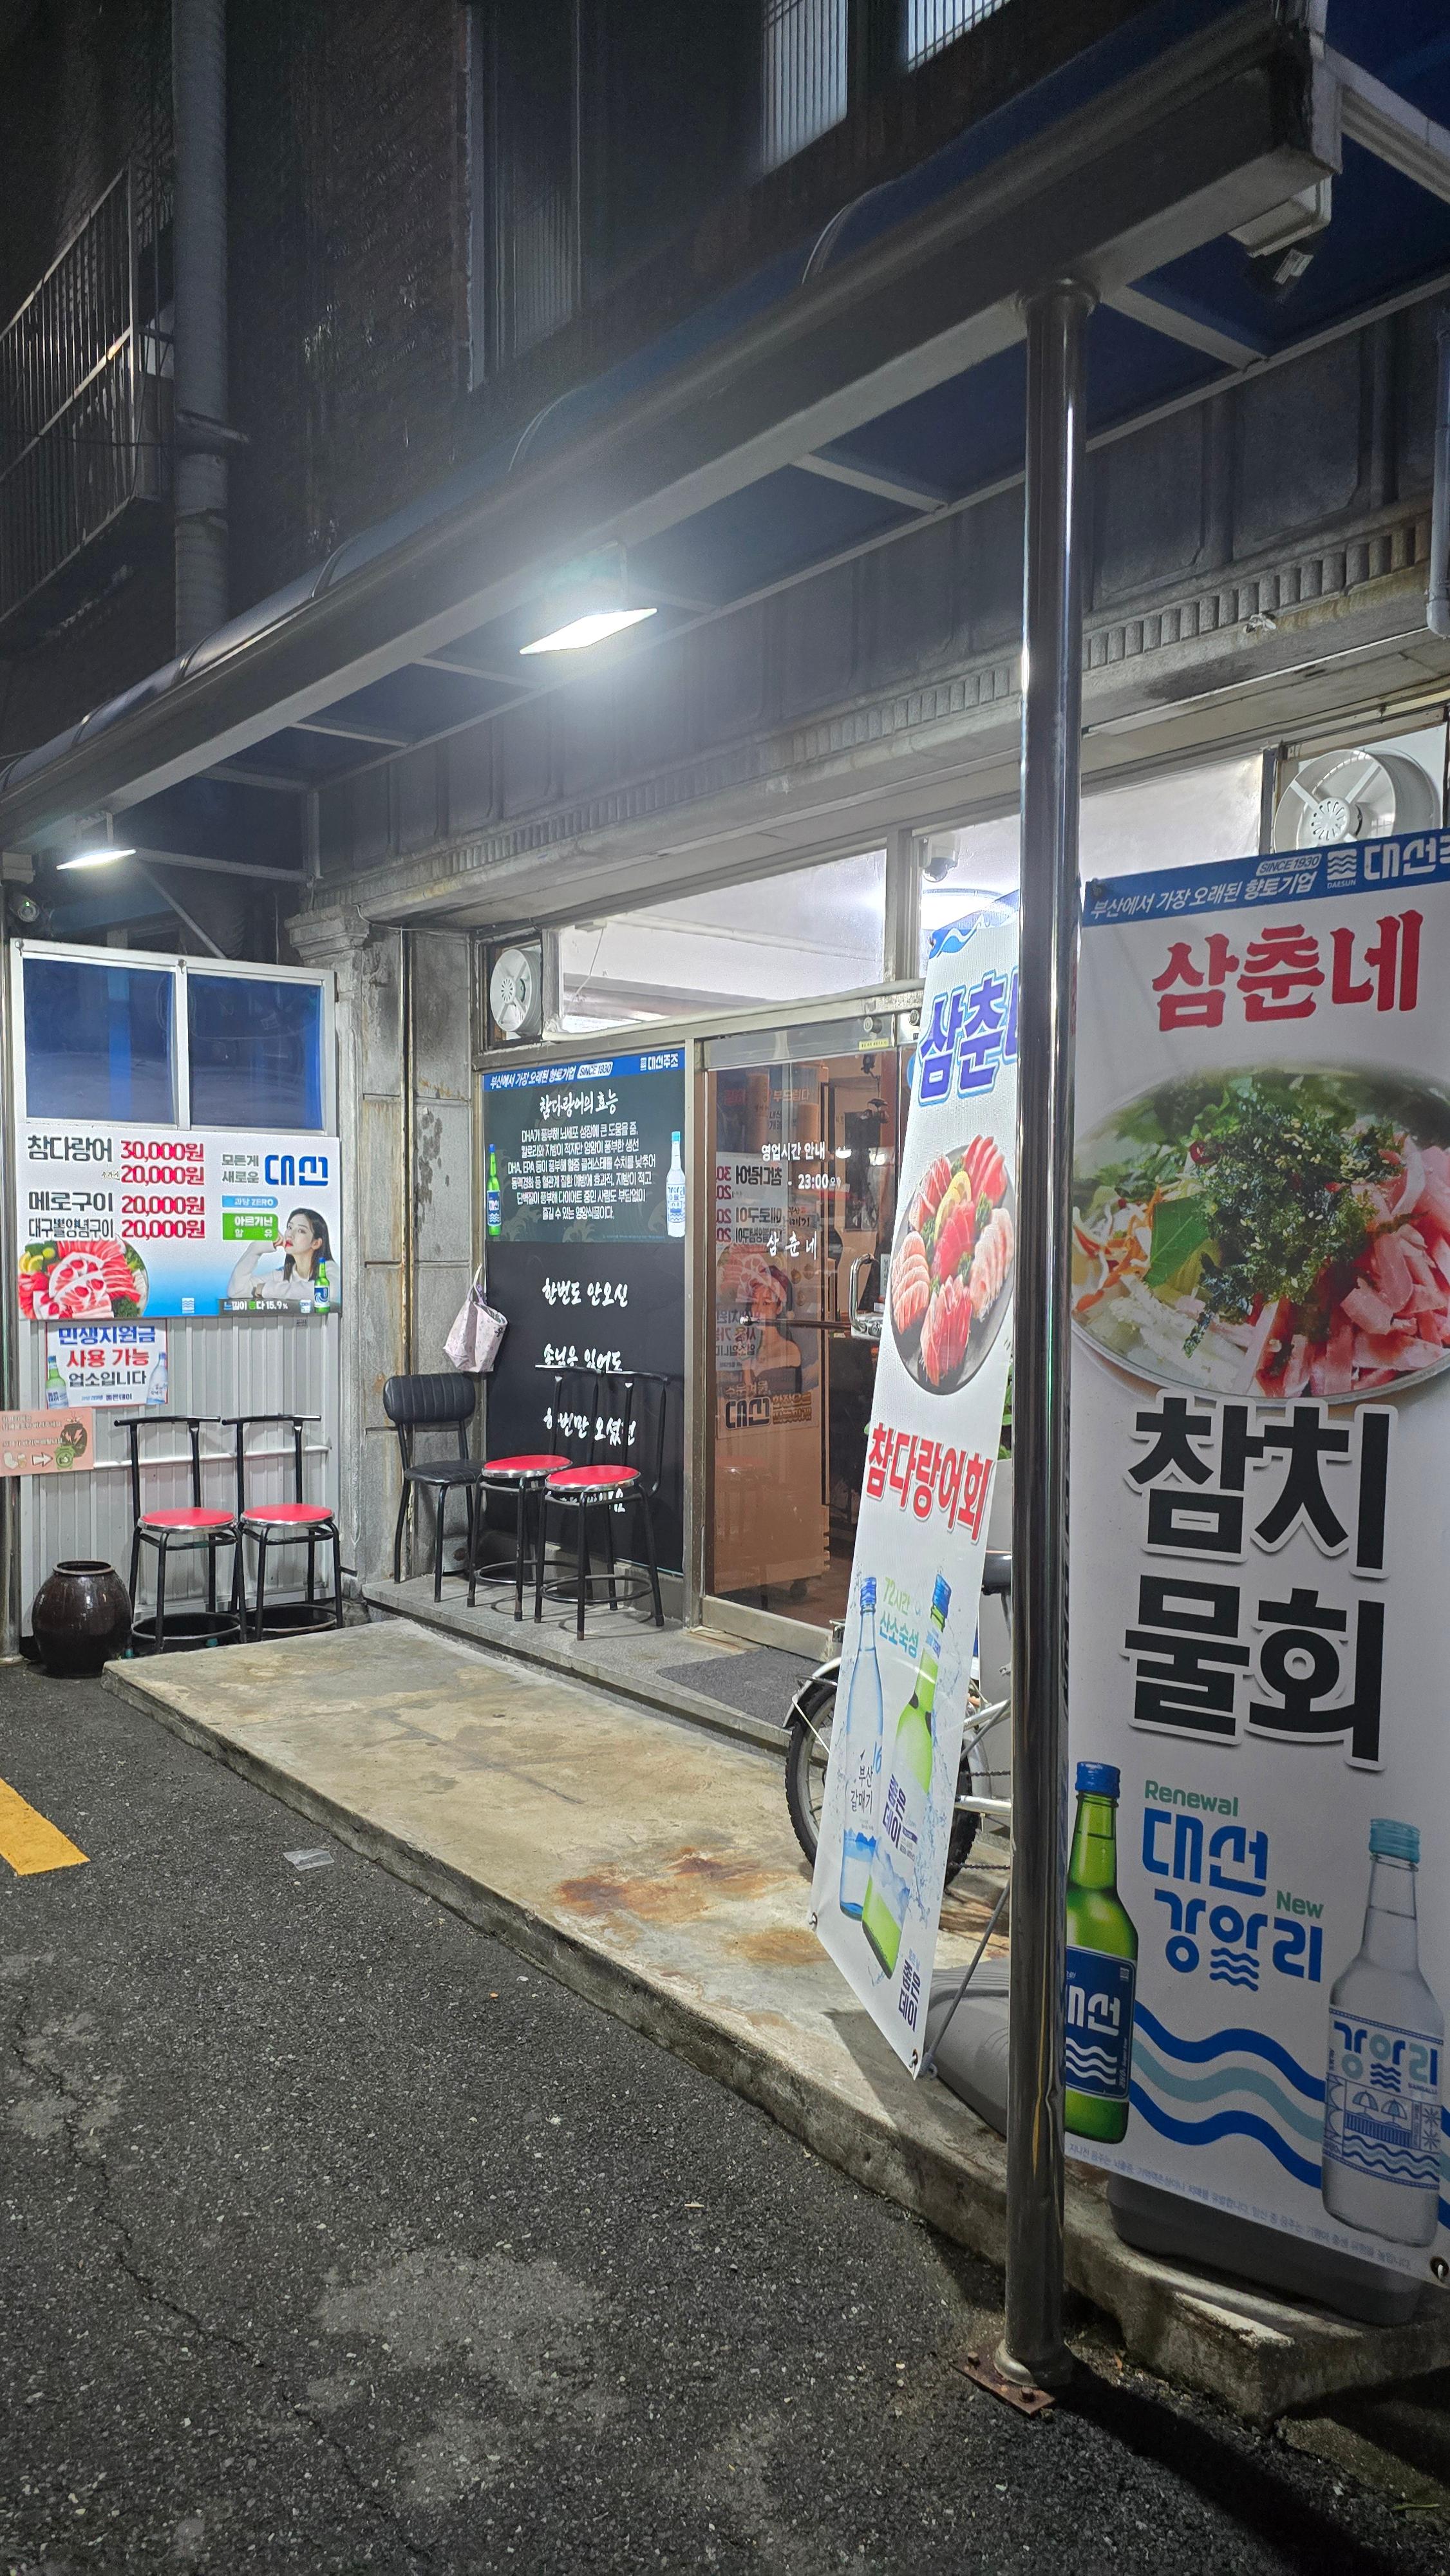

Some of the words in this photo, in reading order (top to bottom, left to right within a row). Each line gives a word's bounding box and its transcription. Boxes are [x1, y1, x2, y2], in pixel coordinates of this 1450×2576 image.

[1259, 860, 1292, 874] SINCE
[1293, 855, 1321, 869] 1930
[1364, 835, 1450, 881] 대선
[1090, 893, 1154, 919] 부산에서
[1156, 889, 1191, 911] 가장
[1193, 882, 1243, 906] 오래된
[1244, 871, 1318, 900] 향토기업
[1327, 879, 1357, 889] DAESUN
[1152, 909, 1424, 1031] 삼춘네
[648, 1053, 679, 1071] 대선주조
[490, 1074, 515, 1090] 부산에서
[515, 1072, 529, 1087] 가장
[529, 1069, 549, 1084] 오래된
[549, 1066, 576, 1083] 향토기업
[579, 1064, 598, 1076] SINCE
[598, 1063, 612, 1074] 1930
[540, 1090, 594, 1121] 참다랑어의
[595, 1088, 619, 1115] 효능
[522, 1129, 540, 1142] DHA가
[541, 1128, 559, 1141] 풍부해
[560, 1126, 578, 1139] 뇌세포
[580, 1124, 599, 1139] 성장에
[600, 1124, 607, 1137] 큰
[608, 1122, 628, 1137] 도움을
[28, 1135, 112, 1162] 참다랑어
[120, 1140, 204, 1162] 30,000원
[221, 1153, 259, 1166] 모든게
[545, 1143, 563, 1157] 지방이
[564, 1142, 583, 1155] 적지만
[605, 1139, 624, 1153] 풍부한
[625, 1139, 639, 1152] 생선
[762, 1142, 801, 1161] 영업시간
[804, 1141, 825, 1160] 안내
[120, 1164, 204, 1186] 20,000원
[265, 1155, 328, 1186] 대선
[523, 1160, 535, 1173] EPA
[536, 1160, 547, 1173] 등이
[549, 1159, 567, 1172] 풍부해
[614, 1155, 634, 1169] 수치를
[635, 1154, 656, 1168] 낮추어
[221, 1170, 259, 1183] 새로운
[535, 1175, 541, 1189] 등
[616, 1172, 636, 1186] 지방이
[637, 1171, 652, 1185] 적고
[798, 1173, 829, 1189] 23:00
[28, 1191, 113, 1212] 메로구이
[122, 1195, 205, 1217] 20,000원
[251, 1198, 274, 1206] ZERO
[540, 1191, 558, 1204] 풍부해
[558, 1190, 582, 1204] 다이어트
[583, 1189, 596, 1203] 중인
[598, 1189, 617, 1202] 사람도
[618, 1188, 646, 1202] 부담없이
[234, 1216, 273, 1227] 아르기닌
[555, 1206, 561, 1220] 수
[562, 1206, 574, 1220] 있는
[28, 1218, 113, 1238] 대구뽈양념구이
[122, 1219, 205, 1240] 20,000원
[542, 1278, 581, 1305] 한번도
[587, 1282, 628, 1307] 안오신
[223, 1301, 247, 1311] 느낌이
[59, 1325, 156, 1345] 민생지원금
[66, 1349, 105, 1368] 사용
[113, 1348, 149, 1367] 가능
[543, 1343, 578, 1367] 손님은
[584, 1348, 623, 1371] 있어도
[69, 1370, 147, 1388] 업소입니다
[726, 1397, 771, 1430] 대선
[867, 1422, 994, 1542] 참다랑어회
[1127, 1396, 1390, 1570] 참치
[879, 1610, 919, 1659] 산소숙성
[1124, 1574, 1386, 1762] 물회
[859, 1765, 873, 1788] 부산
[851, 1788, 873, 1815] 갈매기
[1144, 1779, 1239, 1817] Renewal
[1142, 1807, 1268, 1898] 대선
[1277, 1889, 1324, 1918] New
[1154, 1888, 1324, 1993] 강알리
[1333, 2020, 1438, 2093] 강알리
